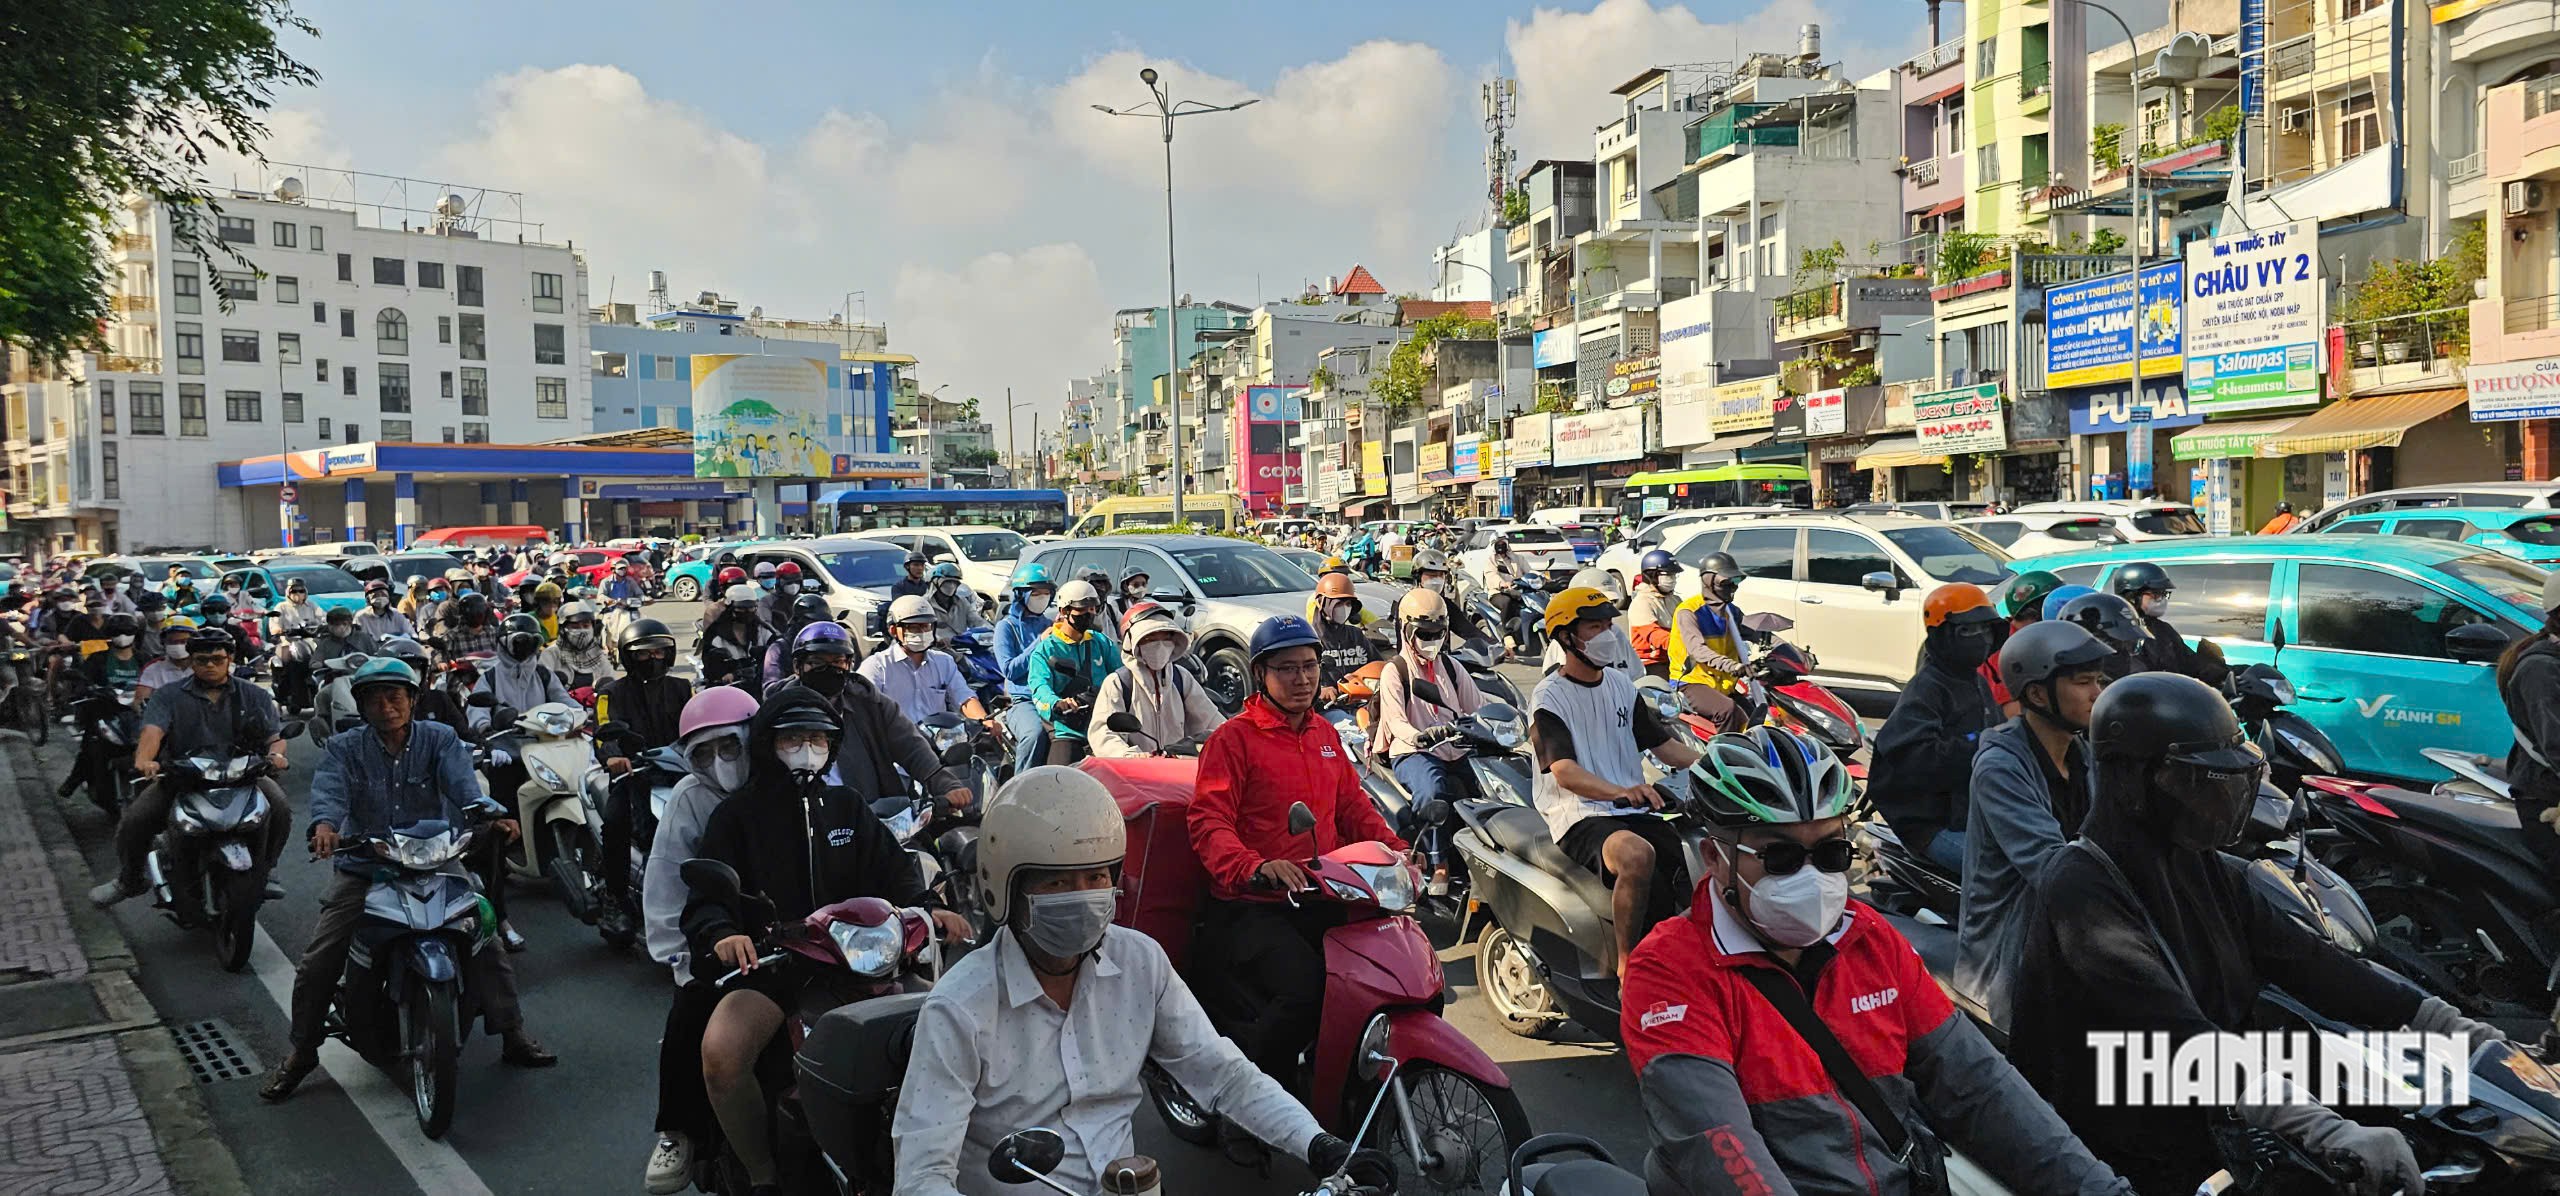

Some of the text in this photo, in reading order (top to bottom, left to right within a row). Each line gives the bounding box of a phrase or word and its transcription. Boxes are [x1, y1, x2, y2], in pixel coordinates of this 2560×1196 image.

[2213, 231, 2286, 258] NHÀ THUỐC TÂY
[2194, 253, 2310, 298] CHÂU VY 2
[2052, 292, 2074, 306] CÔNG
[2075, 290, 2087, 302] TY
[2088, 286, 2110, 299] TNHH
[2163, 272, 2176, 283] AN
[2217, 301, 2226, 311] NHÀ
[2088, 310, 2134, 335] PUMA
[2217, 350, 2284, 373] Salonpas
[1773, 397, 1793, 412] TOP
[1914, 404, 1951, 419] LUCKY
[2089, 385, 2187, 425] PUMA
[2177, 439, 2195, 452] NHÀ
[2197, 437, 2226, 450] THUỐC
[2228, 435, 2245, 449] TÂY
[852, 461, 920, 469] PETROLIMEX
[2330, 471, 2342, 482] TÂY
[2384, 709, 2461, 726] XANH SM
[1644, 1013, 1678, 1025] VIETNAM
